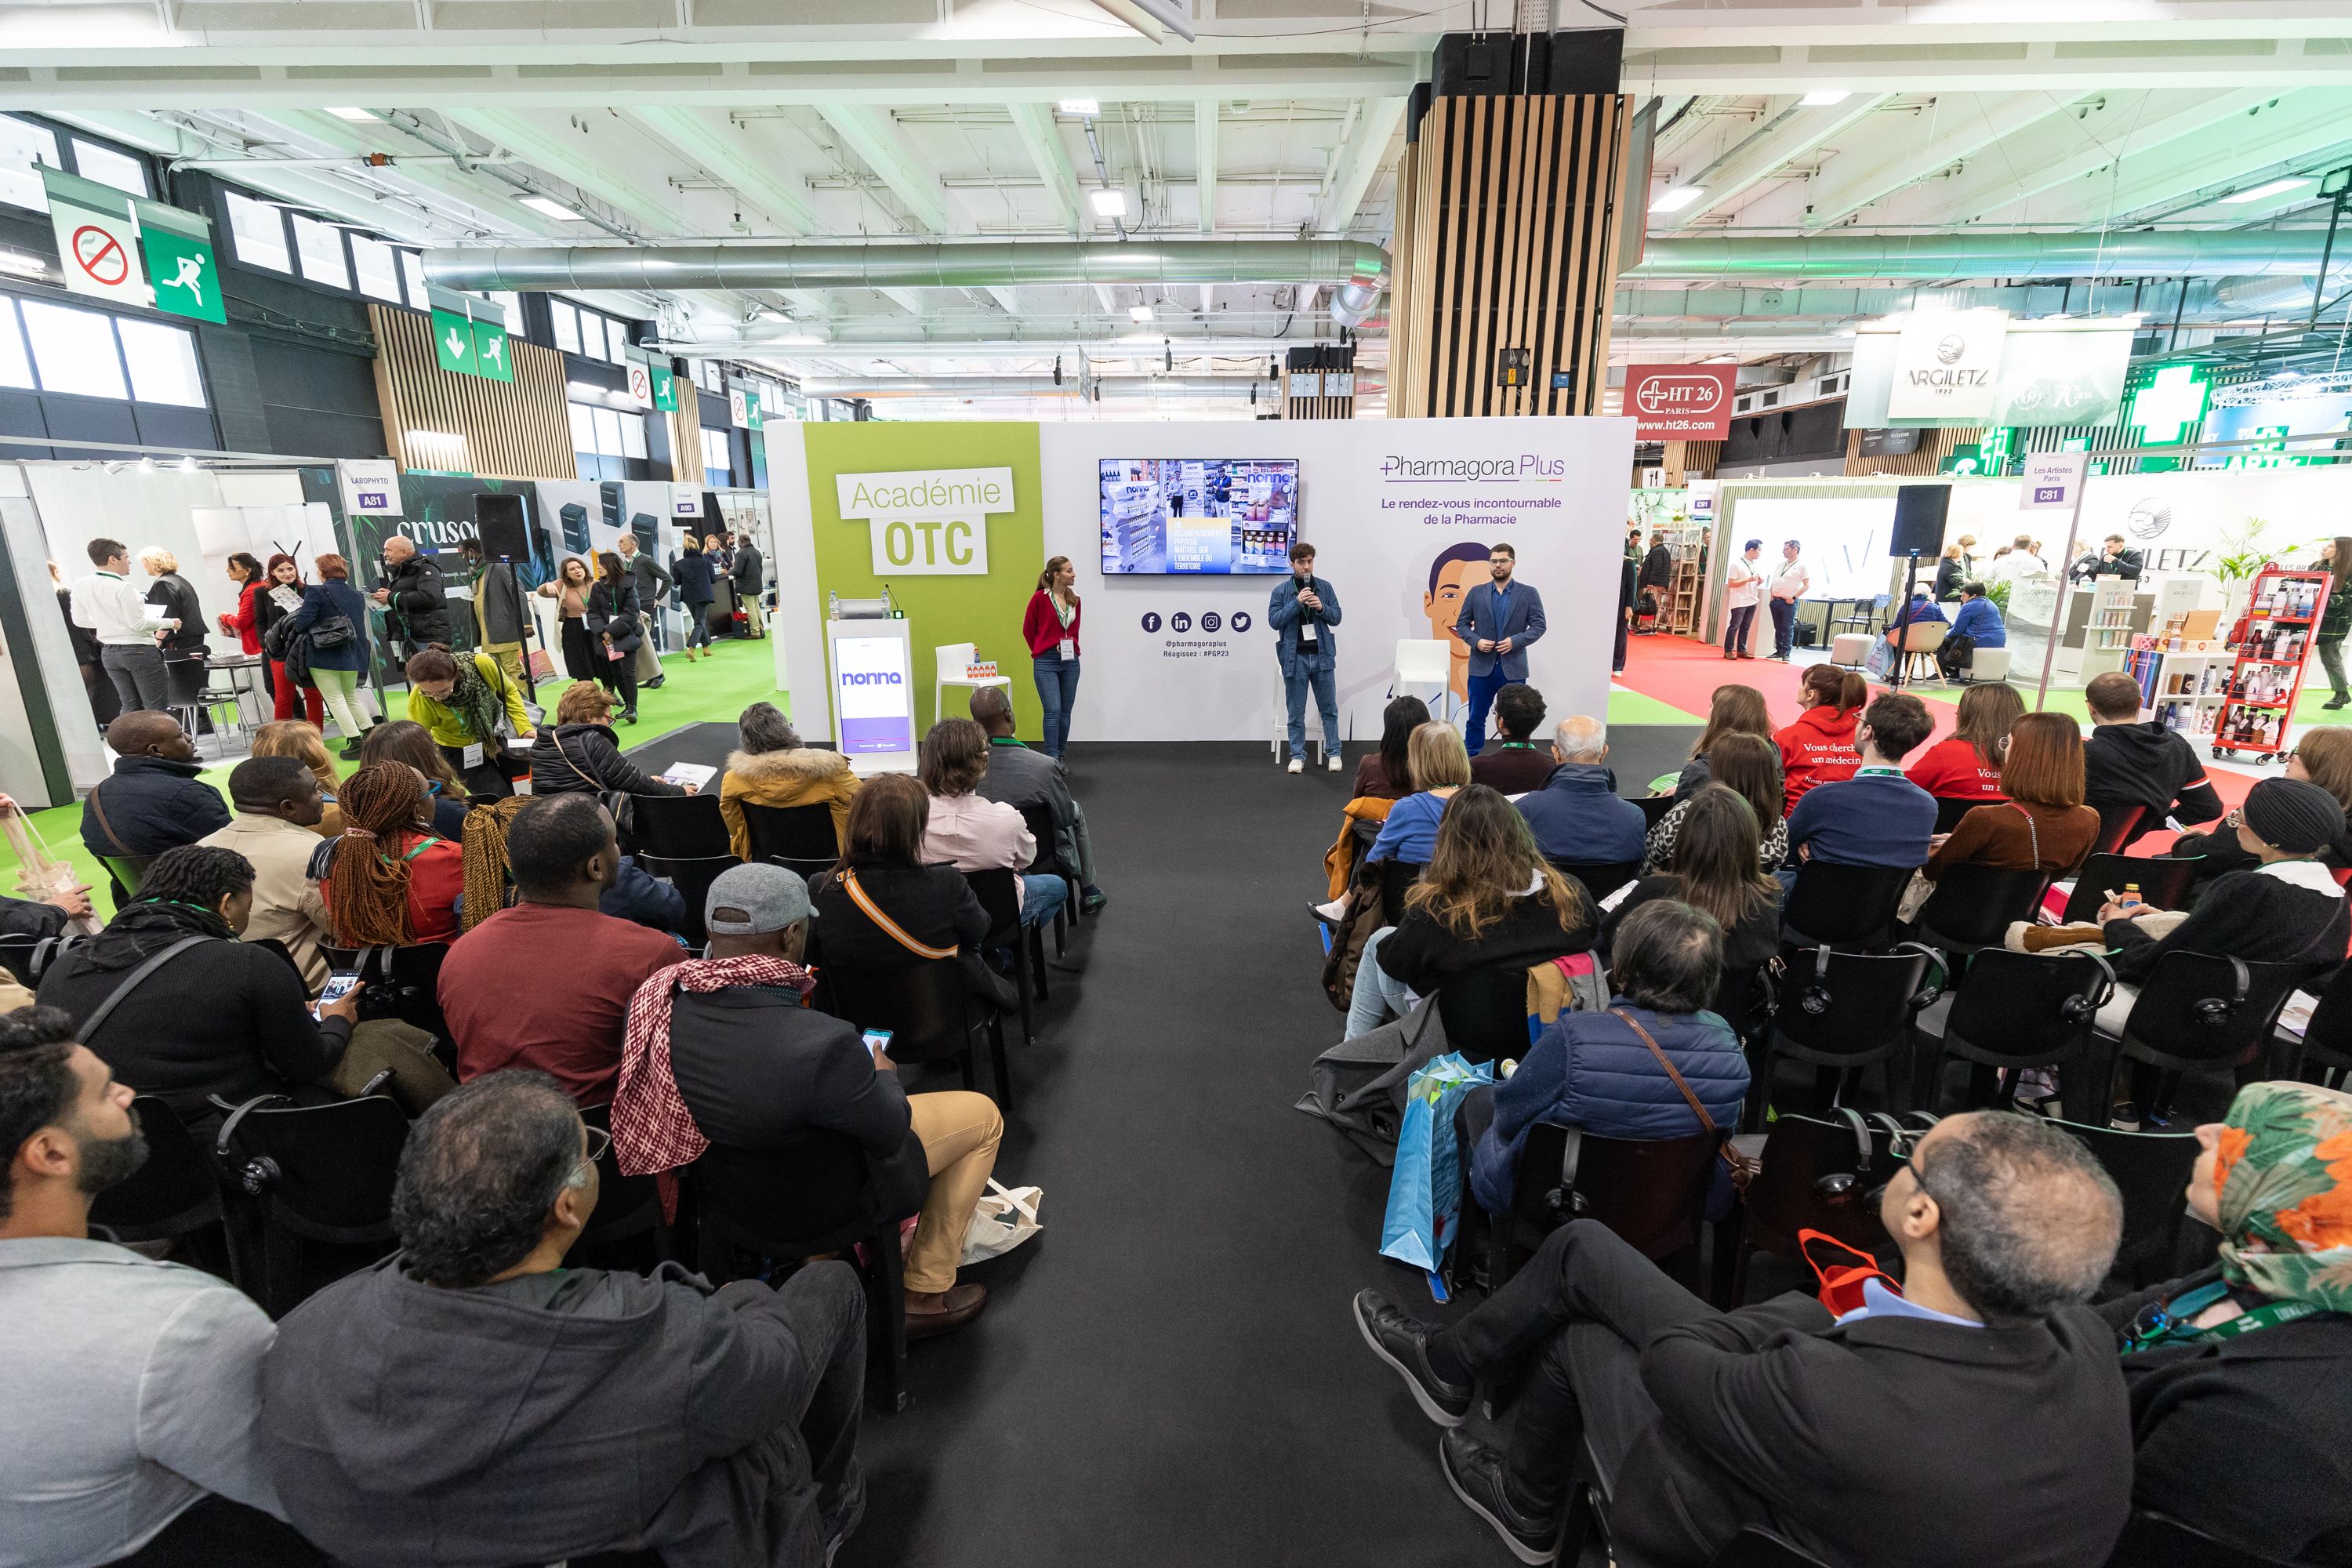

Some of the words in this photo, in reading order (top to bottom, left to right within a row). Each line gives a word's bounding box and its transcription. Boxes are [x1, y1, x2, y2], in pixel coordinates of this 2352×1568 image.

[1907, 369, 1989, 386] ARGILETZ
[1668, 387, 1693, 401] HT
[1696, 387, 1714, 401] 26
[1637, 419, 1715, 430] www.ht26.com
[1519, 455, 1565, 475] Plus
[1247, 473, 1291, 483] nonna
[852, 477, 1000, 509] Académie
[1126, 485, 1149, 494] nonna
[2040, 489, 2058, 500] C81
[364, 496, 382, 506] A81
[1381, 499, 1396, 509] Le
[1399, 499, 1471, 509] rendez-vous
[1474, 498, 1562, 508] incontournable
[1424, 514, 1439, 524] de
[1441, 514, 1451, 524] la
[1454, 514, 1517, 524] Pharmacie
[884, 521, 974, 566] OTC
[842, 672, 902, 685] nonna
[1804, 743, 1828, 753] Vous
[1825, 755, 1861, 764] médecin
[1976, 768, 2001, 779] Vous
[1805, 775, 1823, 785] Nous
